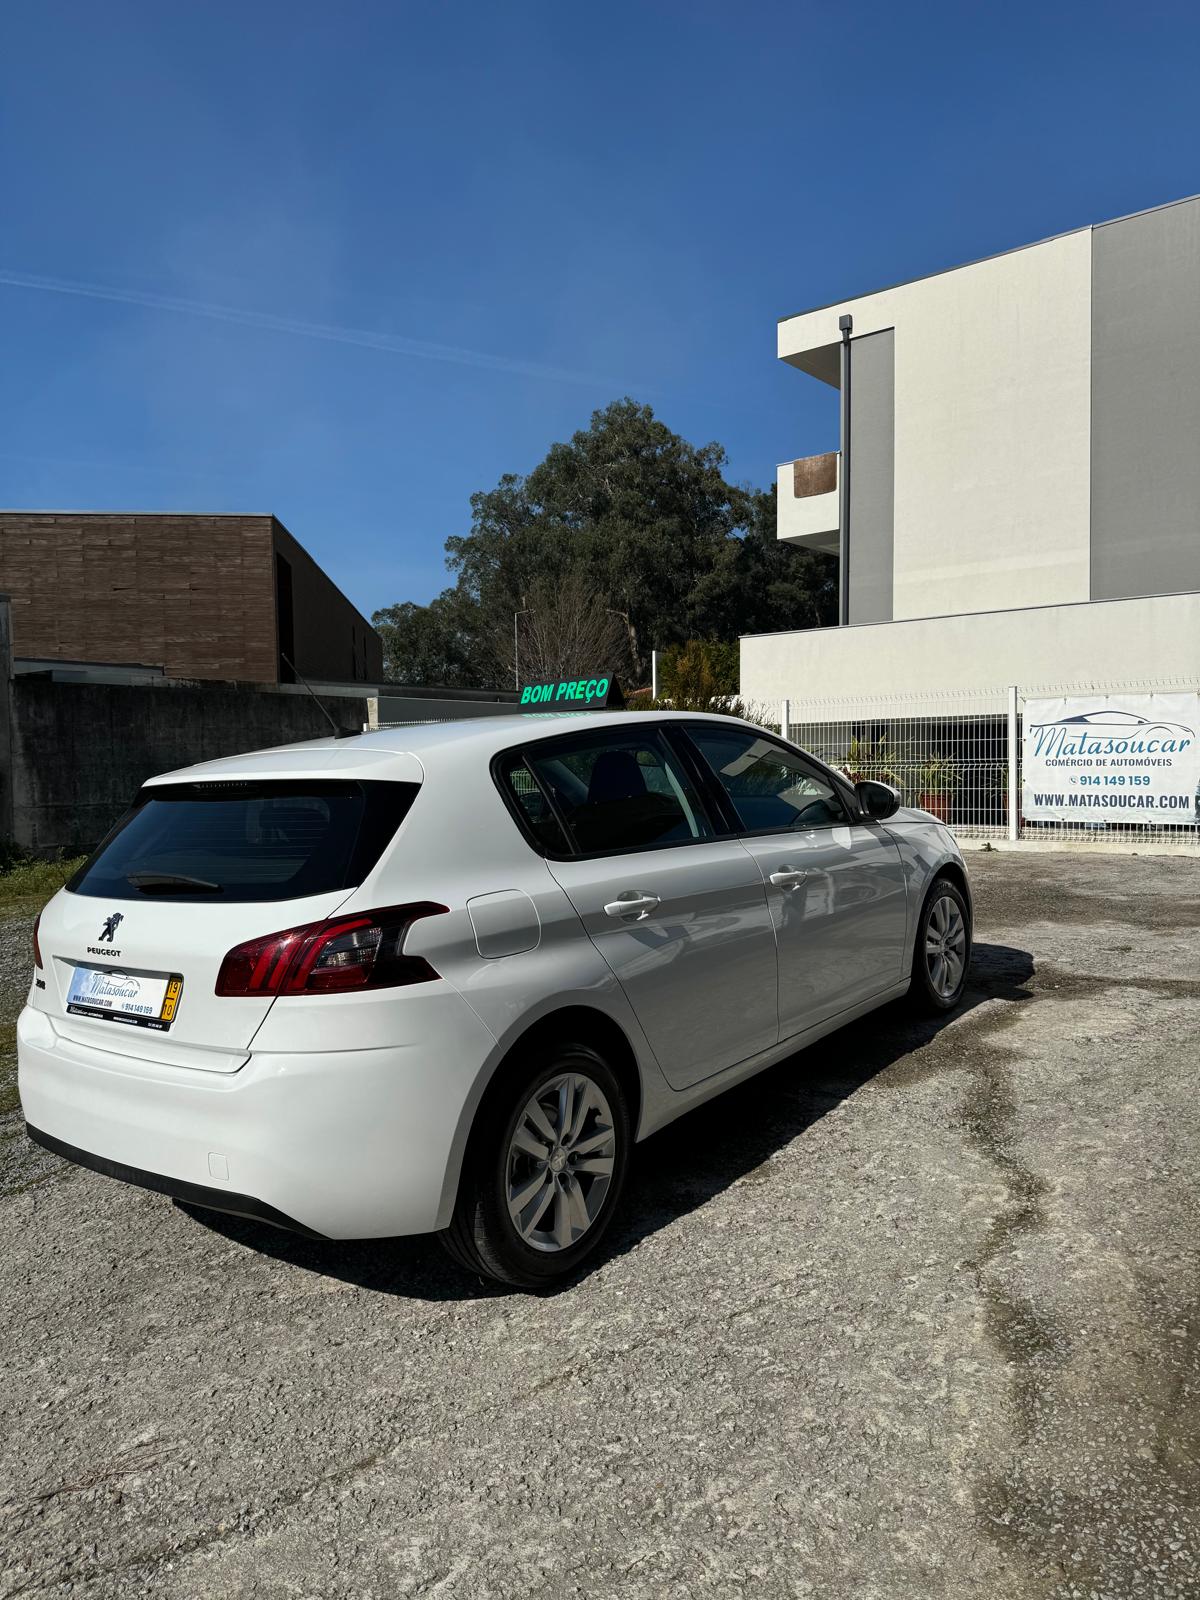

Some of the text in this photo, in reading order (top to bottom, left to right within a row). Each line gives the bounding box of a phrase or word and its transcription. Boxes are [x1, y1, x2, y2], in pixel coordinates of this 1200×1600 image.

[520, 678, 608, 704] BOM PREÇO
[1032, 727, 1190, 758] Matasoucar
[1045, 757, 1172, 767] COMÉRCIO DE AUTOMÓVEIS
[1080, 775, 1150, 786] 914 149 159
[1034, 793, 1189, 808] WWW.MATASOUCAR.COM
[87, 947, 121, 957] PEUGEOT
[91, 975, 138, 998] Matasoucar
[170, 982, 178, 994] 19
[164, 1004, 172, 1016] 10
